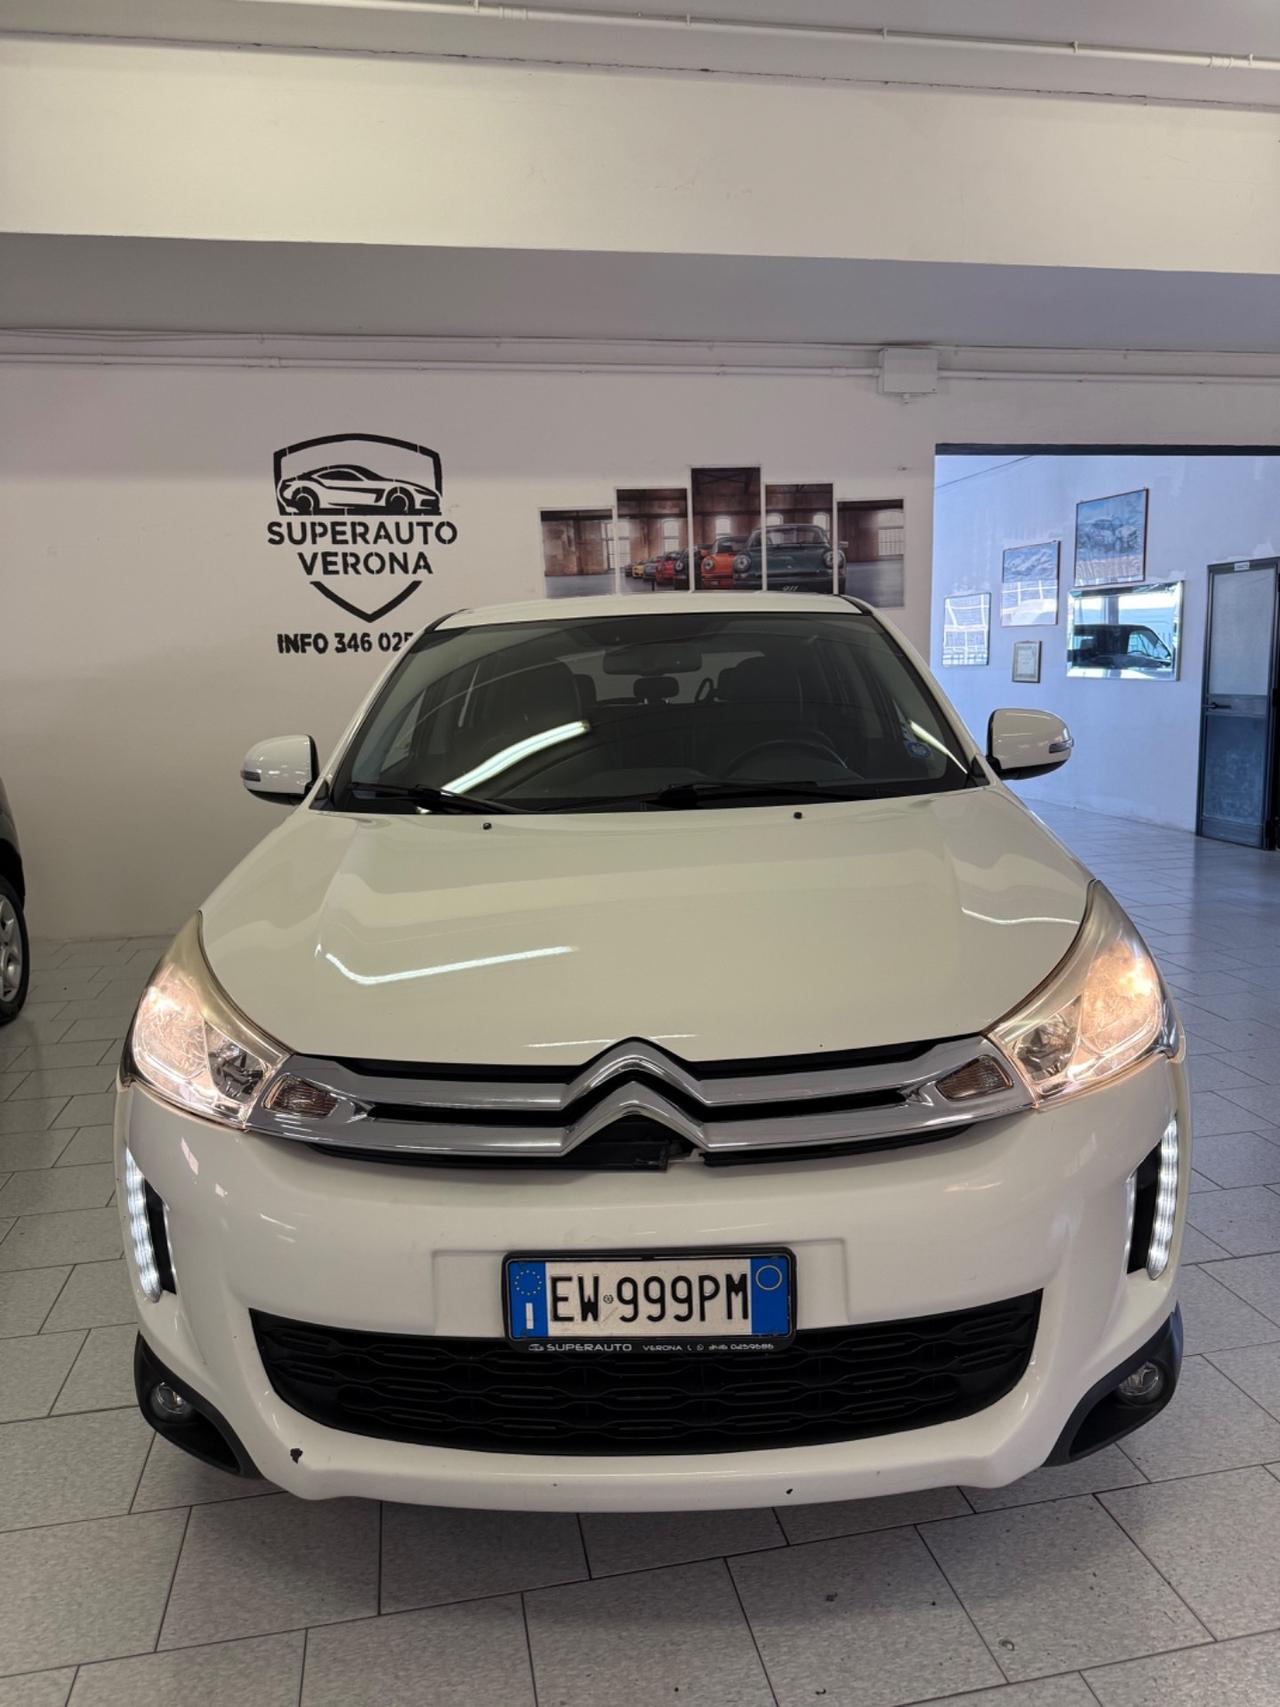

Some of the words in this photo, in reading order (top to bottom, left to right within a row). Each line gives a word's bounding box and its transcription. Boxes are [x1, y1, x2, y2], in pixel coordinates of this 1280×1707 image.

[266, 521, 458, 545] SUPERAUTO
[297, 551, 433, 576] VERONA
[277, 632, 329, 654] INFO
[334, 632, 372, 653] 346
[546, 1343, 632, 1352] SUPERAUTO
